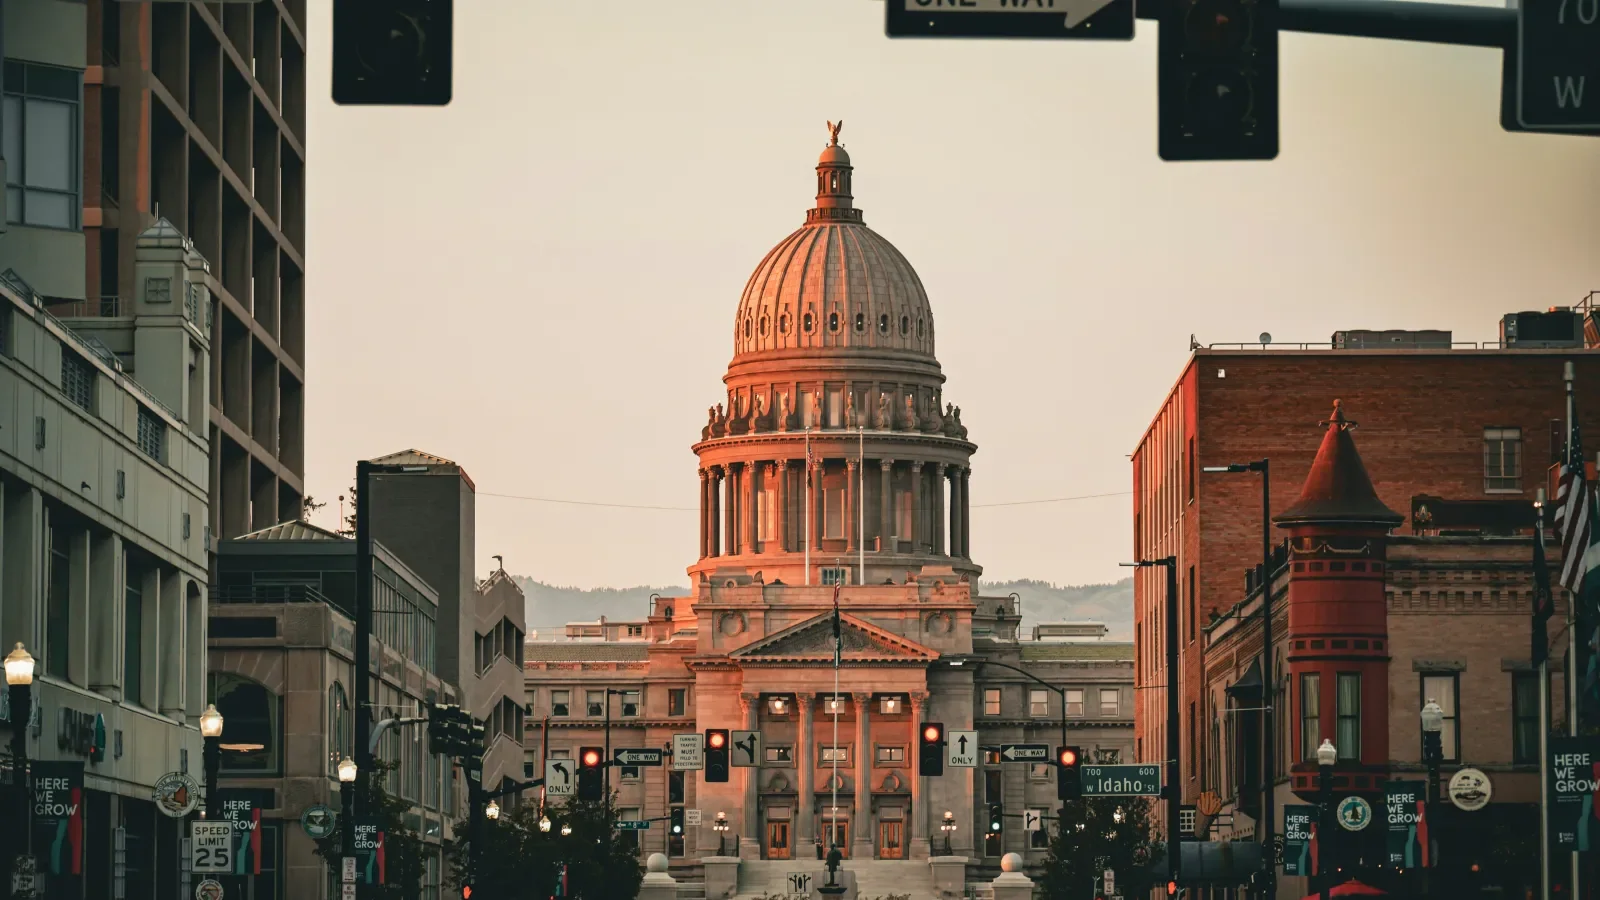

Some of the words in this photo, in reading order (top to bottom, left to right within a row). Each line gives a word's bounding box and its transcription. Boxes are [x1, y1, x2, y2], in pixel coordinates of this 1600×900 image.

[1553, 75, 1585, 108] W
[1554, 753, 1590, 766] HERE
[1086, 768, 1101, 776] 700
[1139, 768, 1155, 776] 600
[1554, 767, 1576, 779] WE
[35, 777, 69, 790] HERE
[1098, 777, 1142, 793] Idaho
[1555, 779, 1600, 792] GROW
[549, 785, 571, 793] ONLY
[35, 790, 54, 803] WE
[1387, 793, 1415, 803] HERE
[34, 803, 78, 816] GROW
[223, 800, 251, 810] HERE
[1387, 804, 1404, 813] WE
[223, 810, 239, 820] WE
[1287, 815, 1310, 824] HERE
[1387, 813, 1423, 824] GROW
[232, 820, 258, 830] ROW
[354, 825, 377, 833] HERE
[1286, 823, 1300, 832] WE
[195, 826, 230, 835] SPEED
[1286, 831, 1315, 840] GROW
[198, 838, 226, 846] LIMIT
[354, 833, 367, 841] WE
[354, 840, 382, 849] GROW
[195, 848, 229, 867] 25
